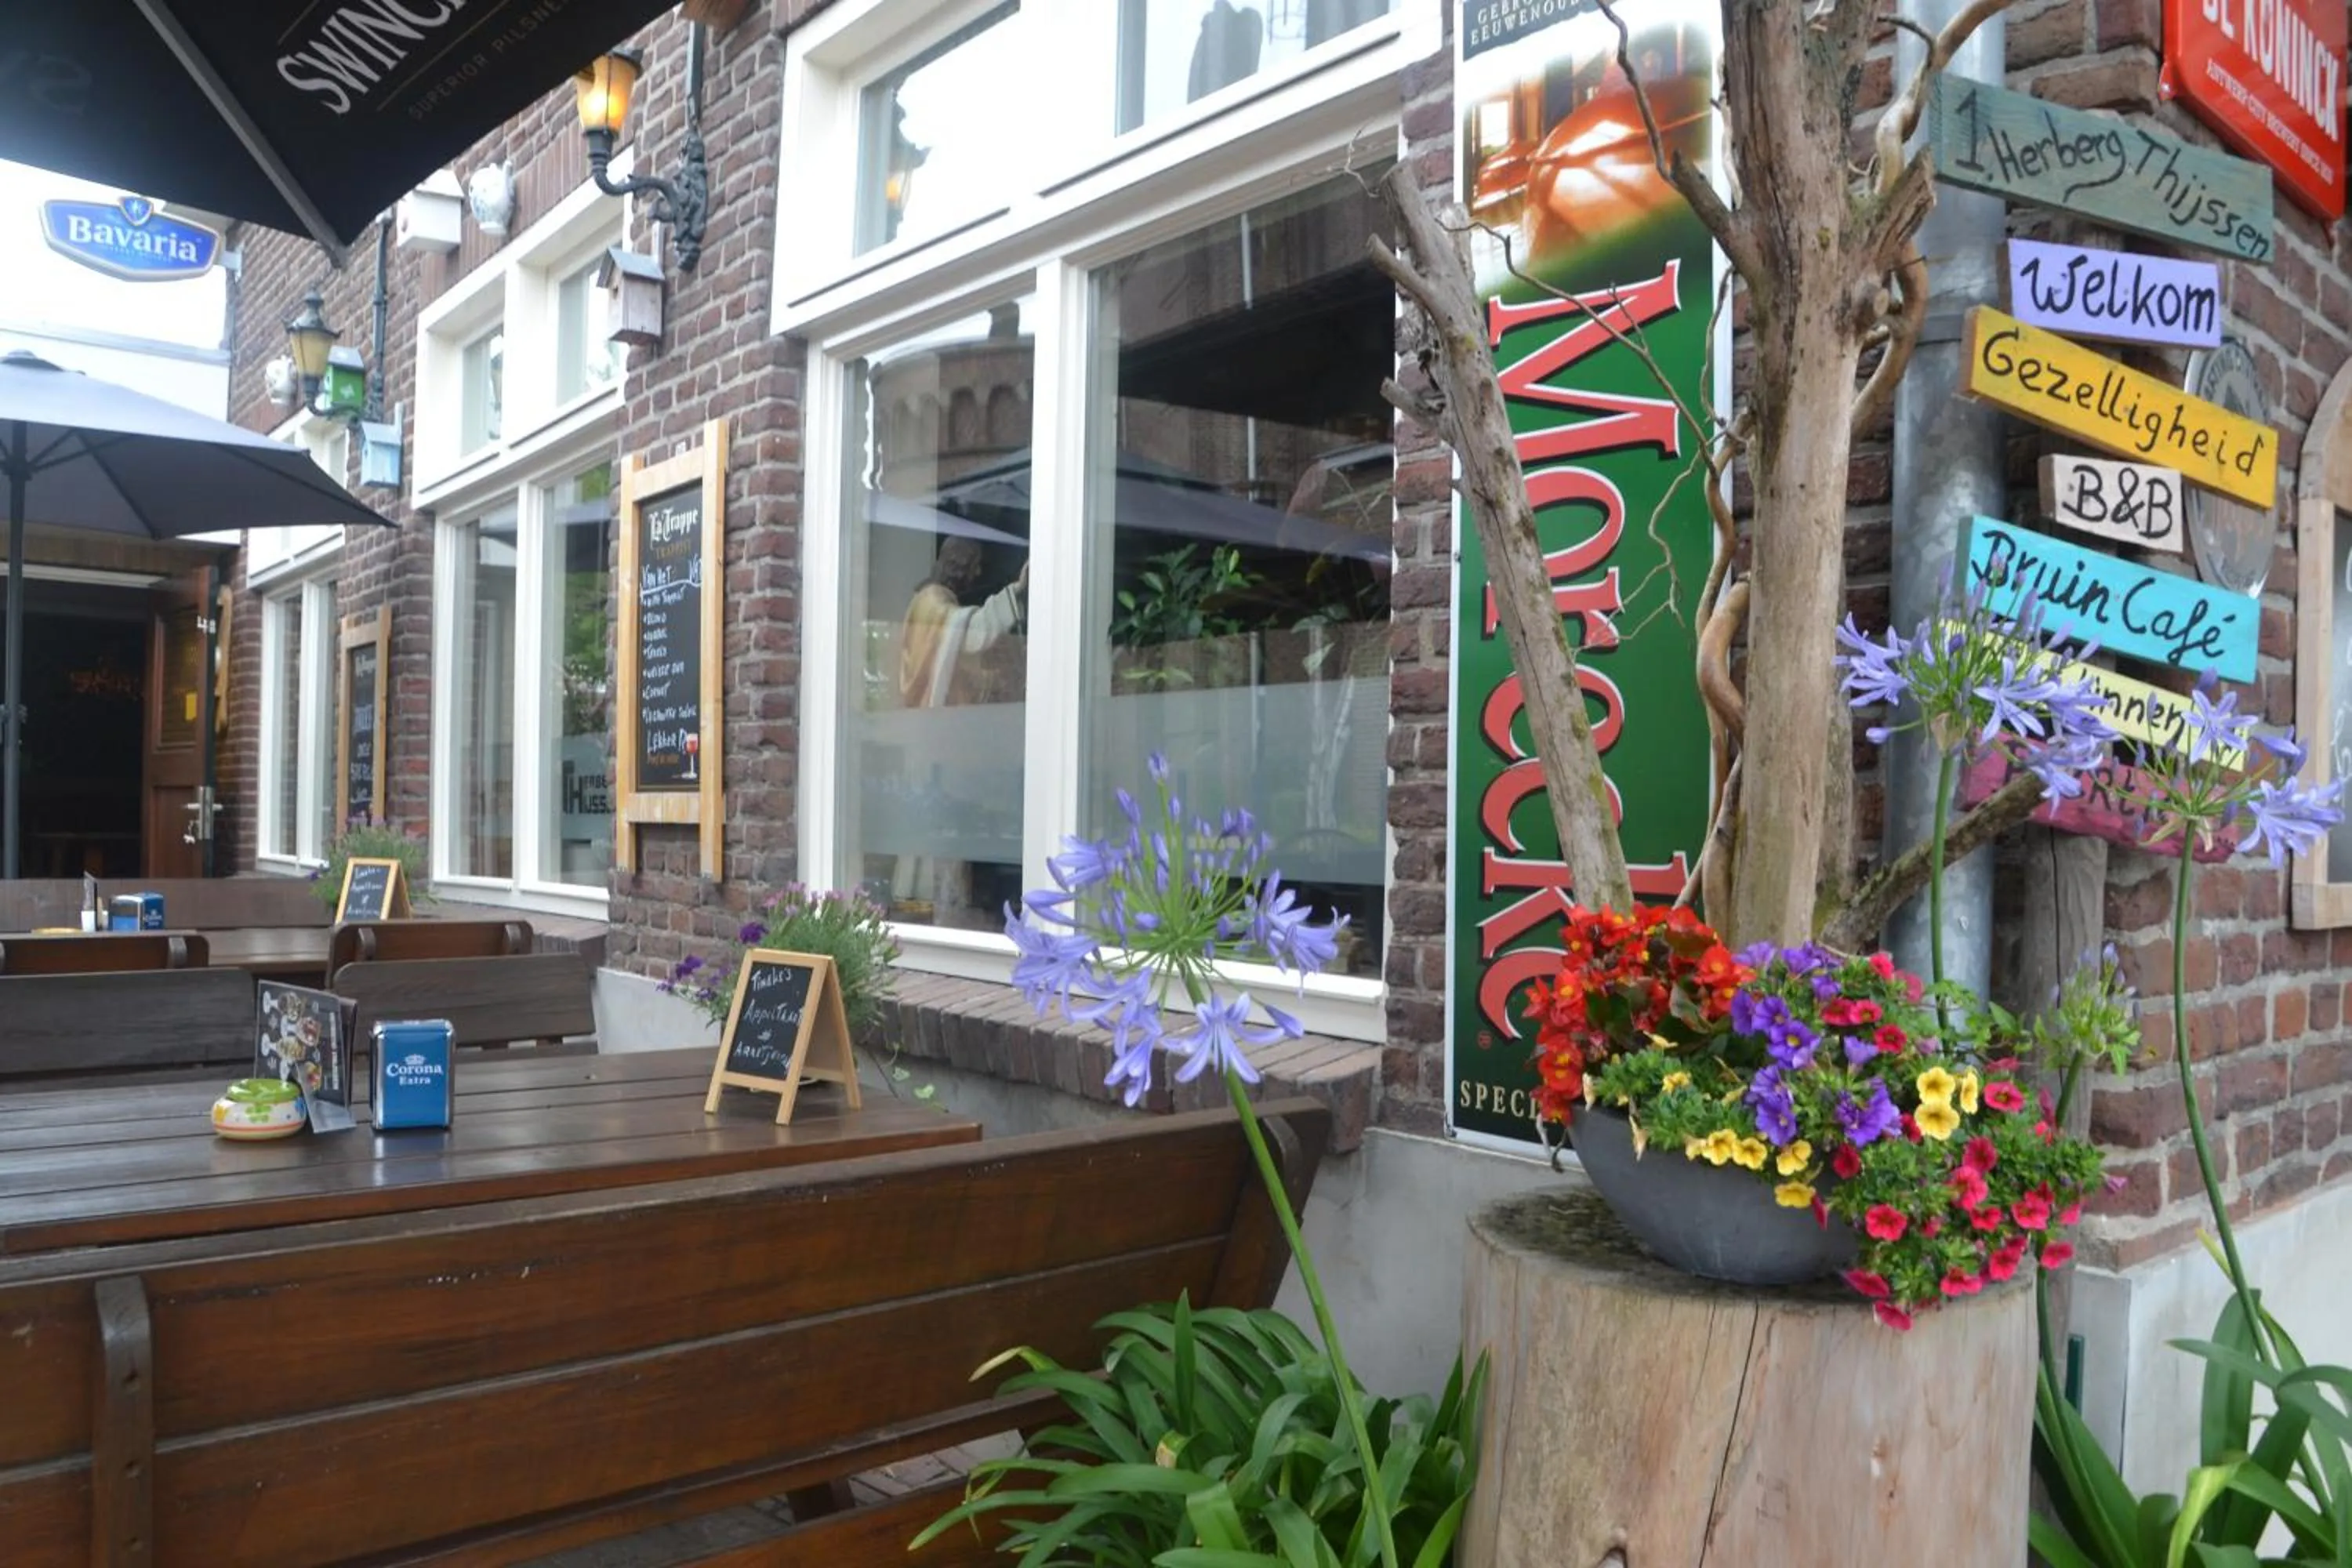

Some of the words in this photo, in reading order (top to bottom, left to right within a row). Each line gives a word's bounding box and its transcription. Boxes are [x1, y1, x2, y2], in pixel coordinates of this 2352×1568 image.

[277, 0, 464, 114] SWINC
[408, 53, 489, 119] SUPERIOR
[492, 0, 568, 53] PILSNE
[2244, 0, 2339, 142] KONINCK
[1987, 111, 2126, 202] Herberg
[2135, 129, 2270, 259] Thijssen
[67, 214, 198, 262] Bavaria
[2020, 255, 2216, 333] Welkom
[1983, 327, 2264, 477] Gezelligheid
[662, 507, 699, 543] Trappe
[2062, 464, 2173, 539] B&B
[1972, 530, 2108, 624] Bruin
[2122, 577, 2237, 665] Café
[386, 1062, 444, 1077] Corona
[399, 1076, 431, 1086] Extra
[1460, 1080, 1557, 1122] SPECI
